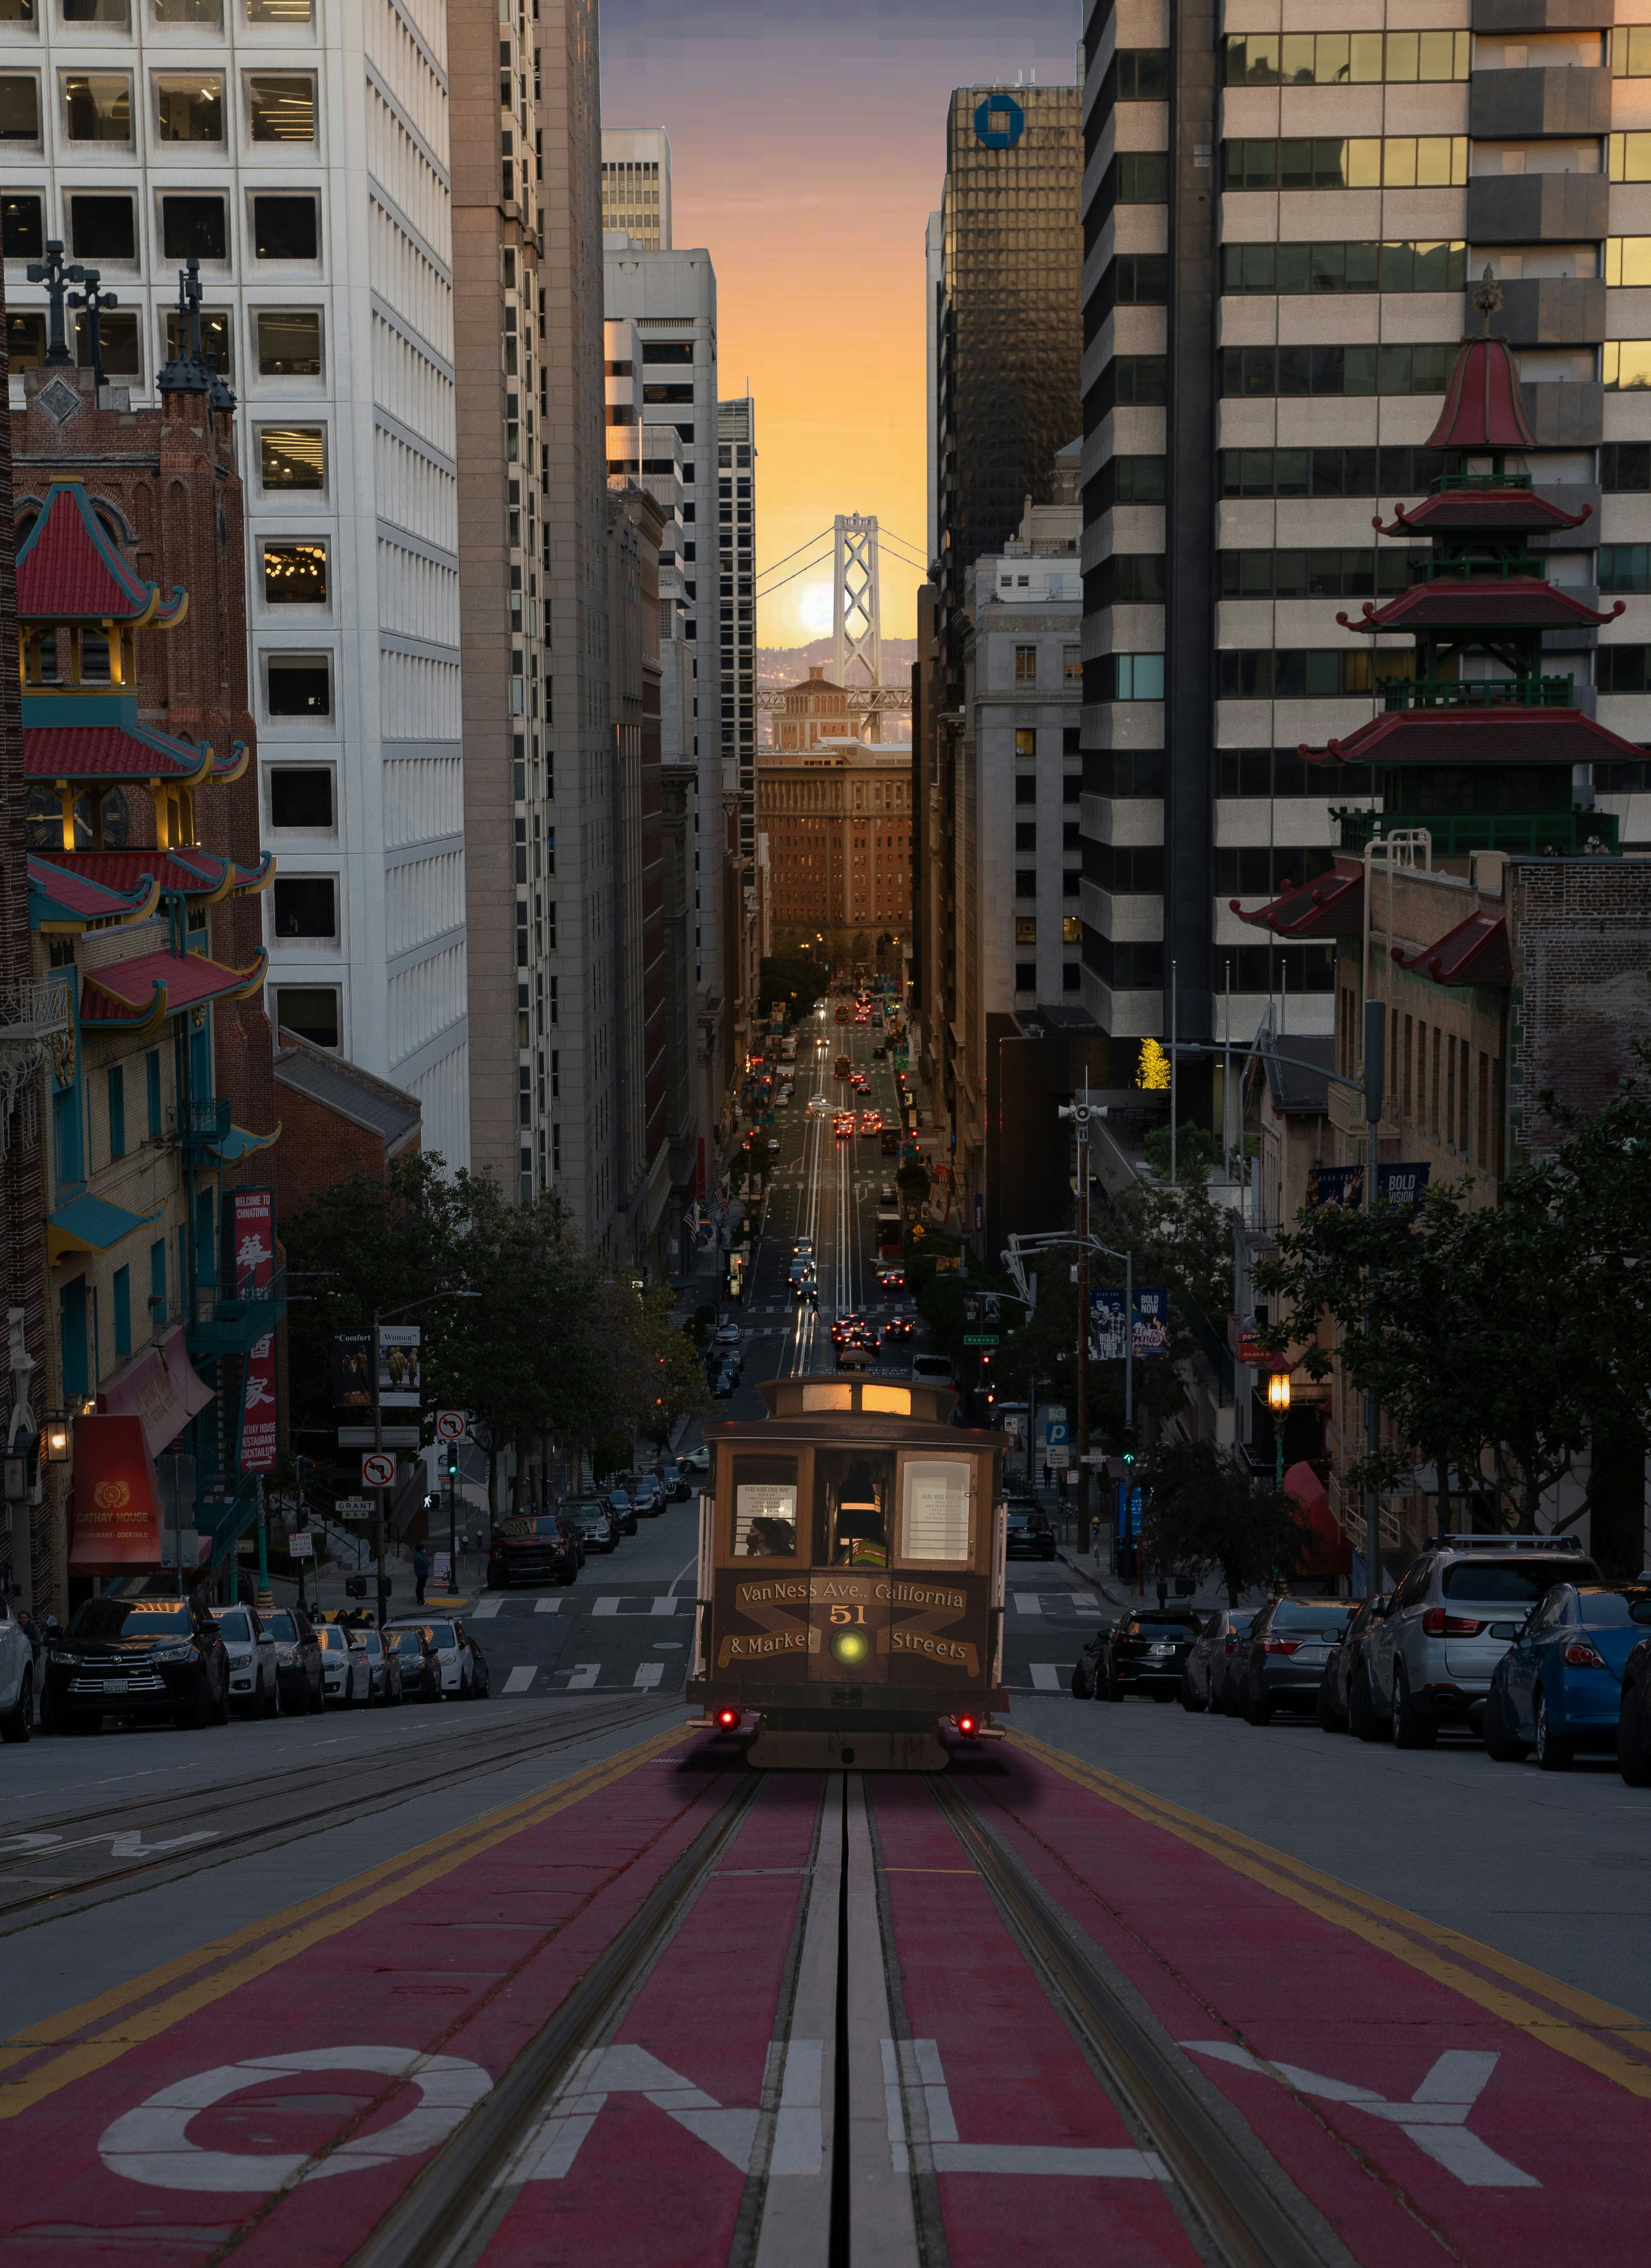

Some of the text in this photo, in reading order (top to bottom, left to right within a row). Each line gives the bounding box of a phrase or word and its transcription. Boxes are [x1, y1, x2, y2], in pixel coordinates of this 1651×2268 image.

[1389, 1174, 1416, 1191] BOLD
[235, 1195, 270, 1207] WELCOME TO
[1389, 1191, 1414, 1203] VISION
[237, 1207, 269, 1219] CHINATOWN
[1141, 1295, 1159, 1304] BOLD
[1141, 1304, 1159, 1313] NOW
[1099, 1333, 1117, 1342] BOLD
[1099, 1342, 1117, 1351] THEN
[243, 1422, 276, 1435] ATHAY HOUSE
[1050, 1425, 1066, 1443] P
[242, 1434, 276, 1447] RESTAURANT
[241, 1446, 269, 1459] COCKTAILS
[77, 1512, 149, 1523] CATHAY HOUSE
[741, 1587, 772, 1602] Van
[775, 1583, 817, 1599] Ness
[875, 1584, 964, 1609] California
[830, 1605, 868, 1624] 51
[731, 1632, 967, 1659] & Market Streets
[97, 2039, 1542, 2193] ONLY
